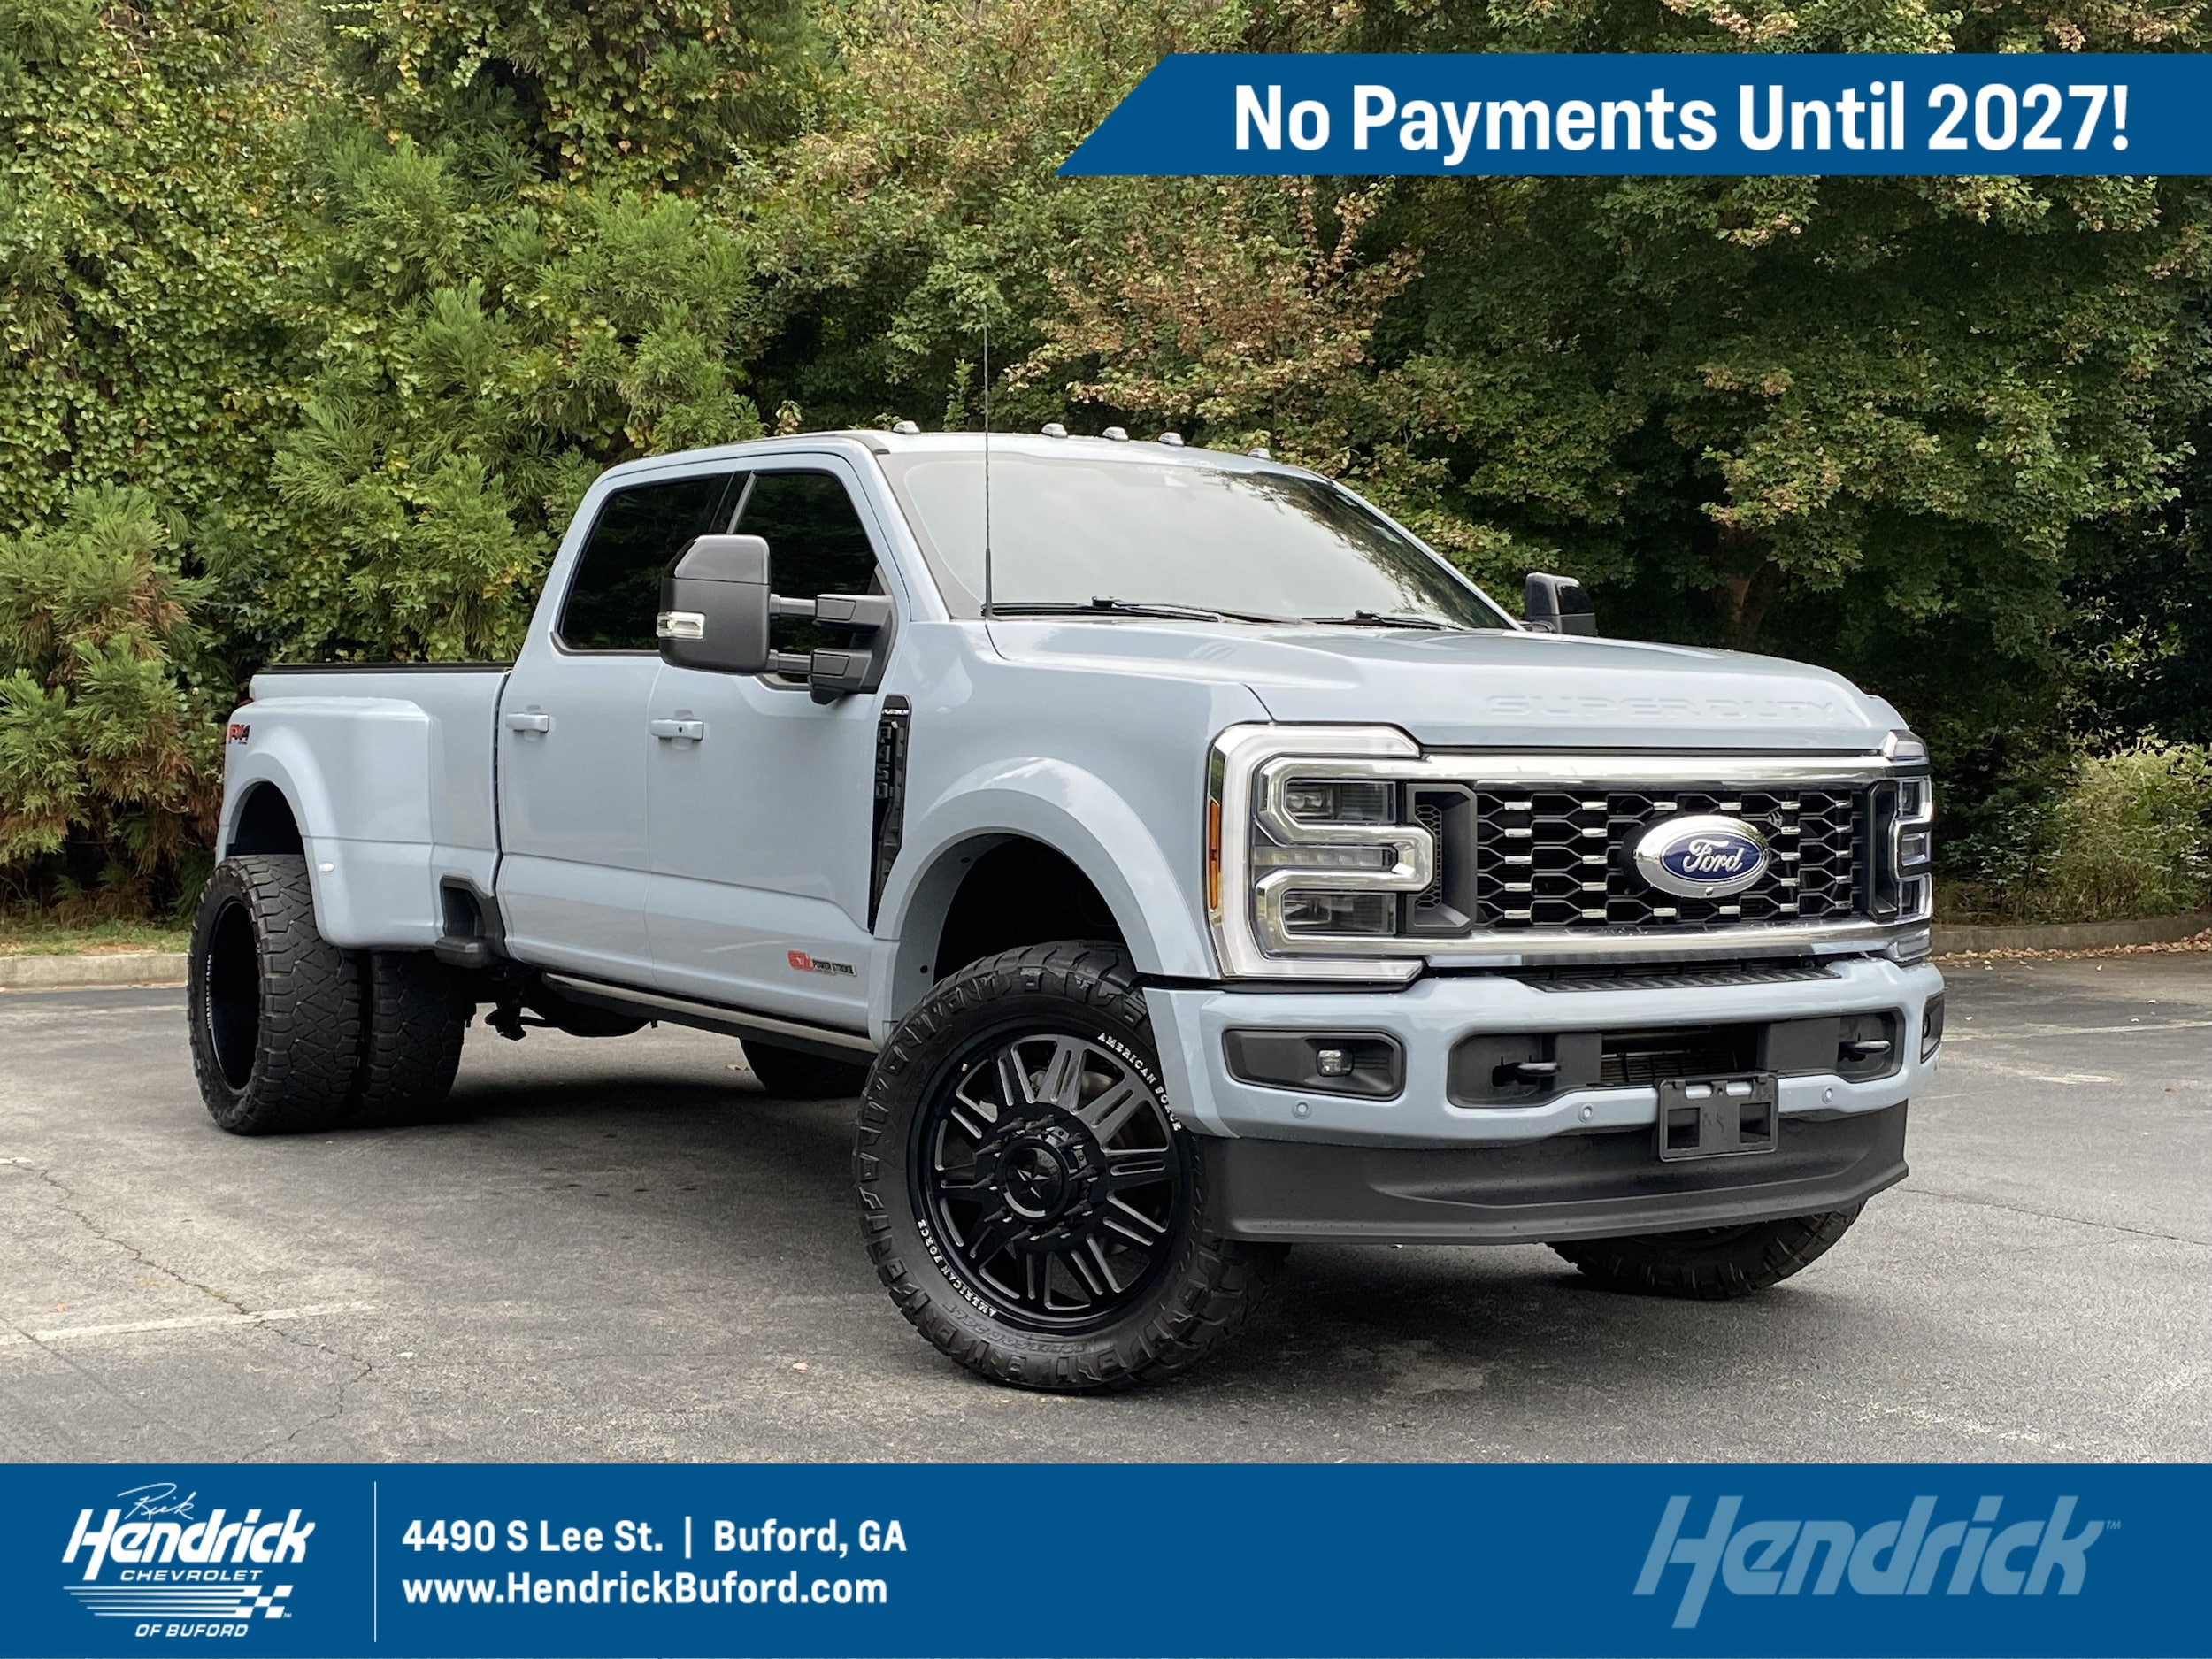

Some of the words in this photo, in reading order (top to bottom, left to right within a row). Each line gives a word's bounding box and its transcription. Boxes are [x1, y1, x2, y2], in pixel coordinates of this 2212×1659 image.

[1486, 695, 1700, 719] SUPER
[1705, 699, 1834, 721] DUTY
[1682, 838, 1745, 873] Ford
[1097, 1033, 1157, 1084] AMERICAN
[918, 1219, 943, 1263] FORCE
[941, 1265, 997, 1317] AMERICAN
